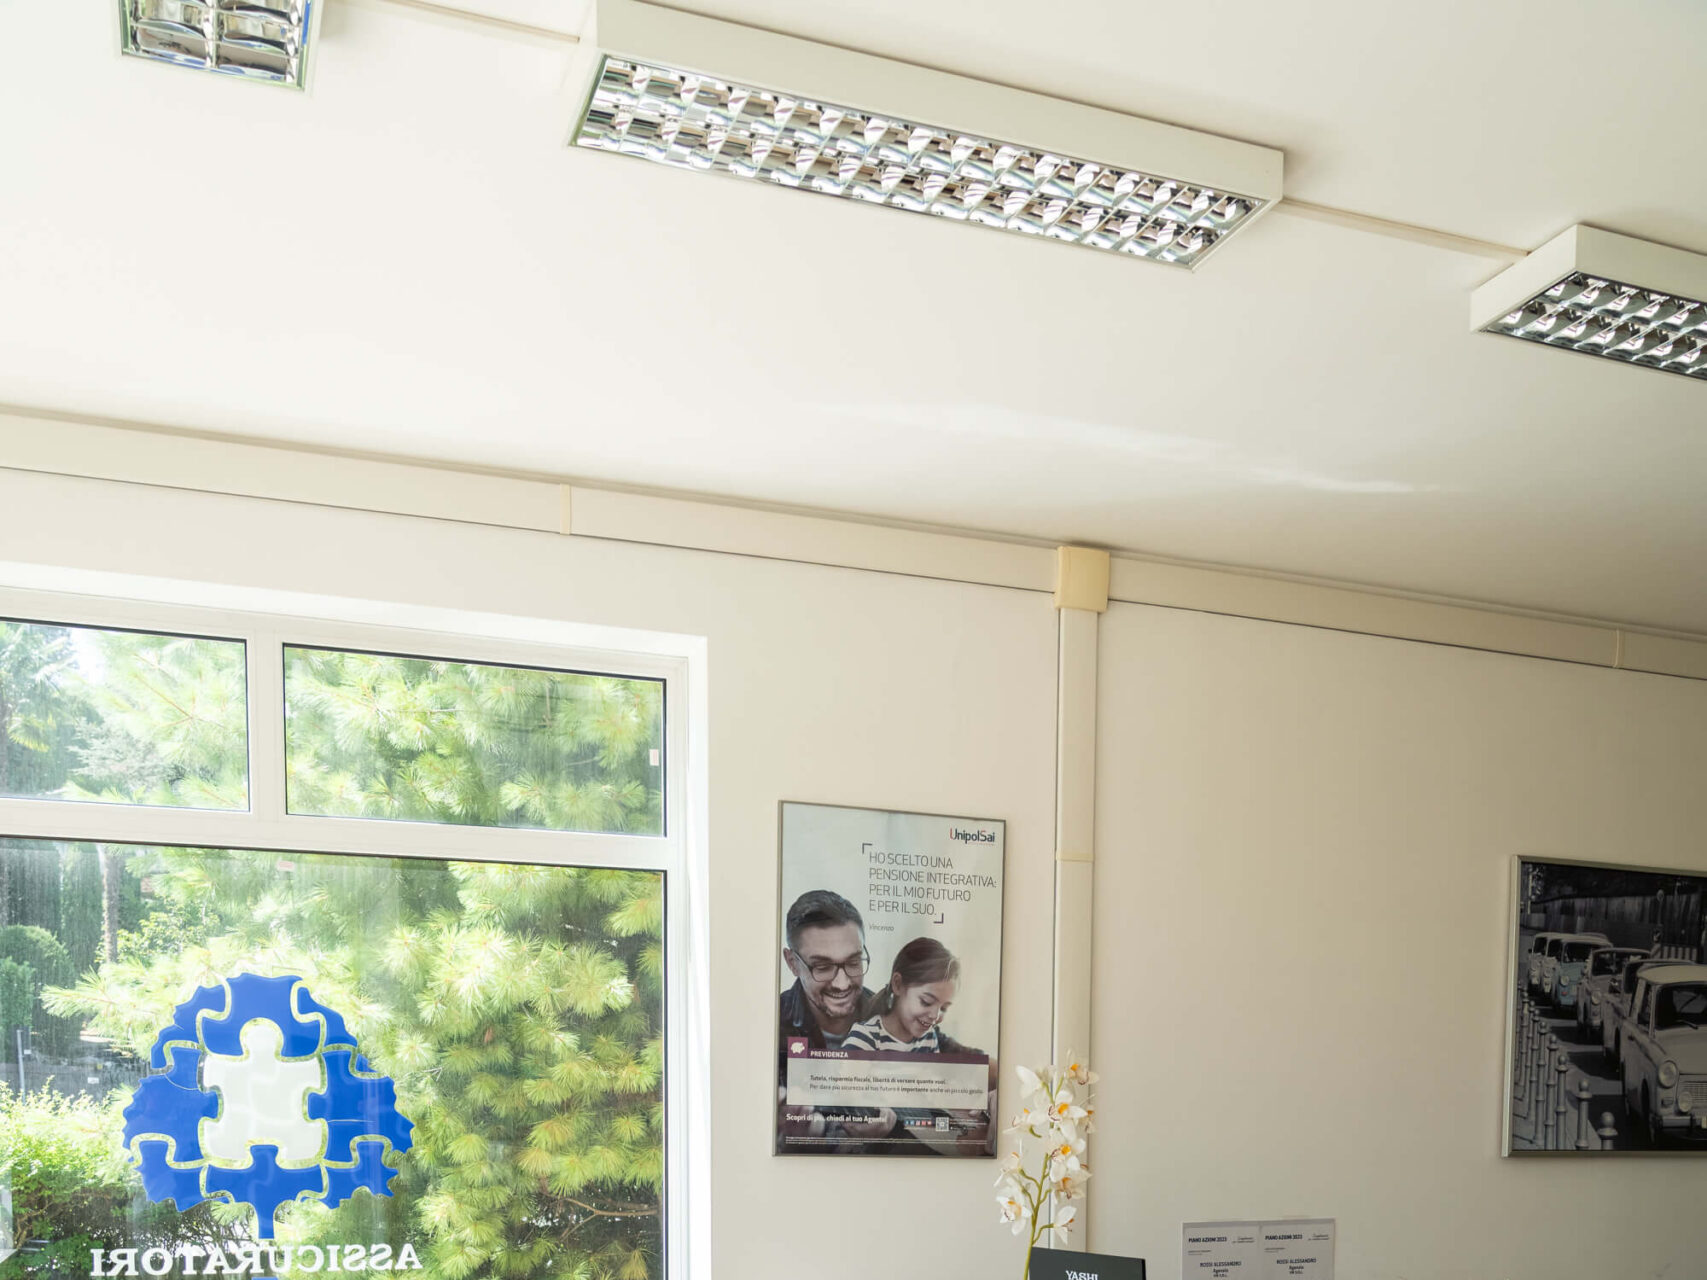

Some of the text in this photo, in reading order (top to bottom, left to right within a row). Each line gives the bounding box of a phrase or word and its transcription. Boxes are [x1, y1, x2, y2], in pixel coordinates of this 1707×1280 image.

[950, 828, 995, 844] UnipolSai
[869, 852, 952, 868] HO SCELTO UNA
[869, 868, 924, 883] PENSIONE
[869, 884, 971, 901] PER IL MIO FUTURO
[869, 900, 937, 916] E PER IL SUO.
[786, 1113, 805, 1122] Scopri
